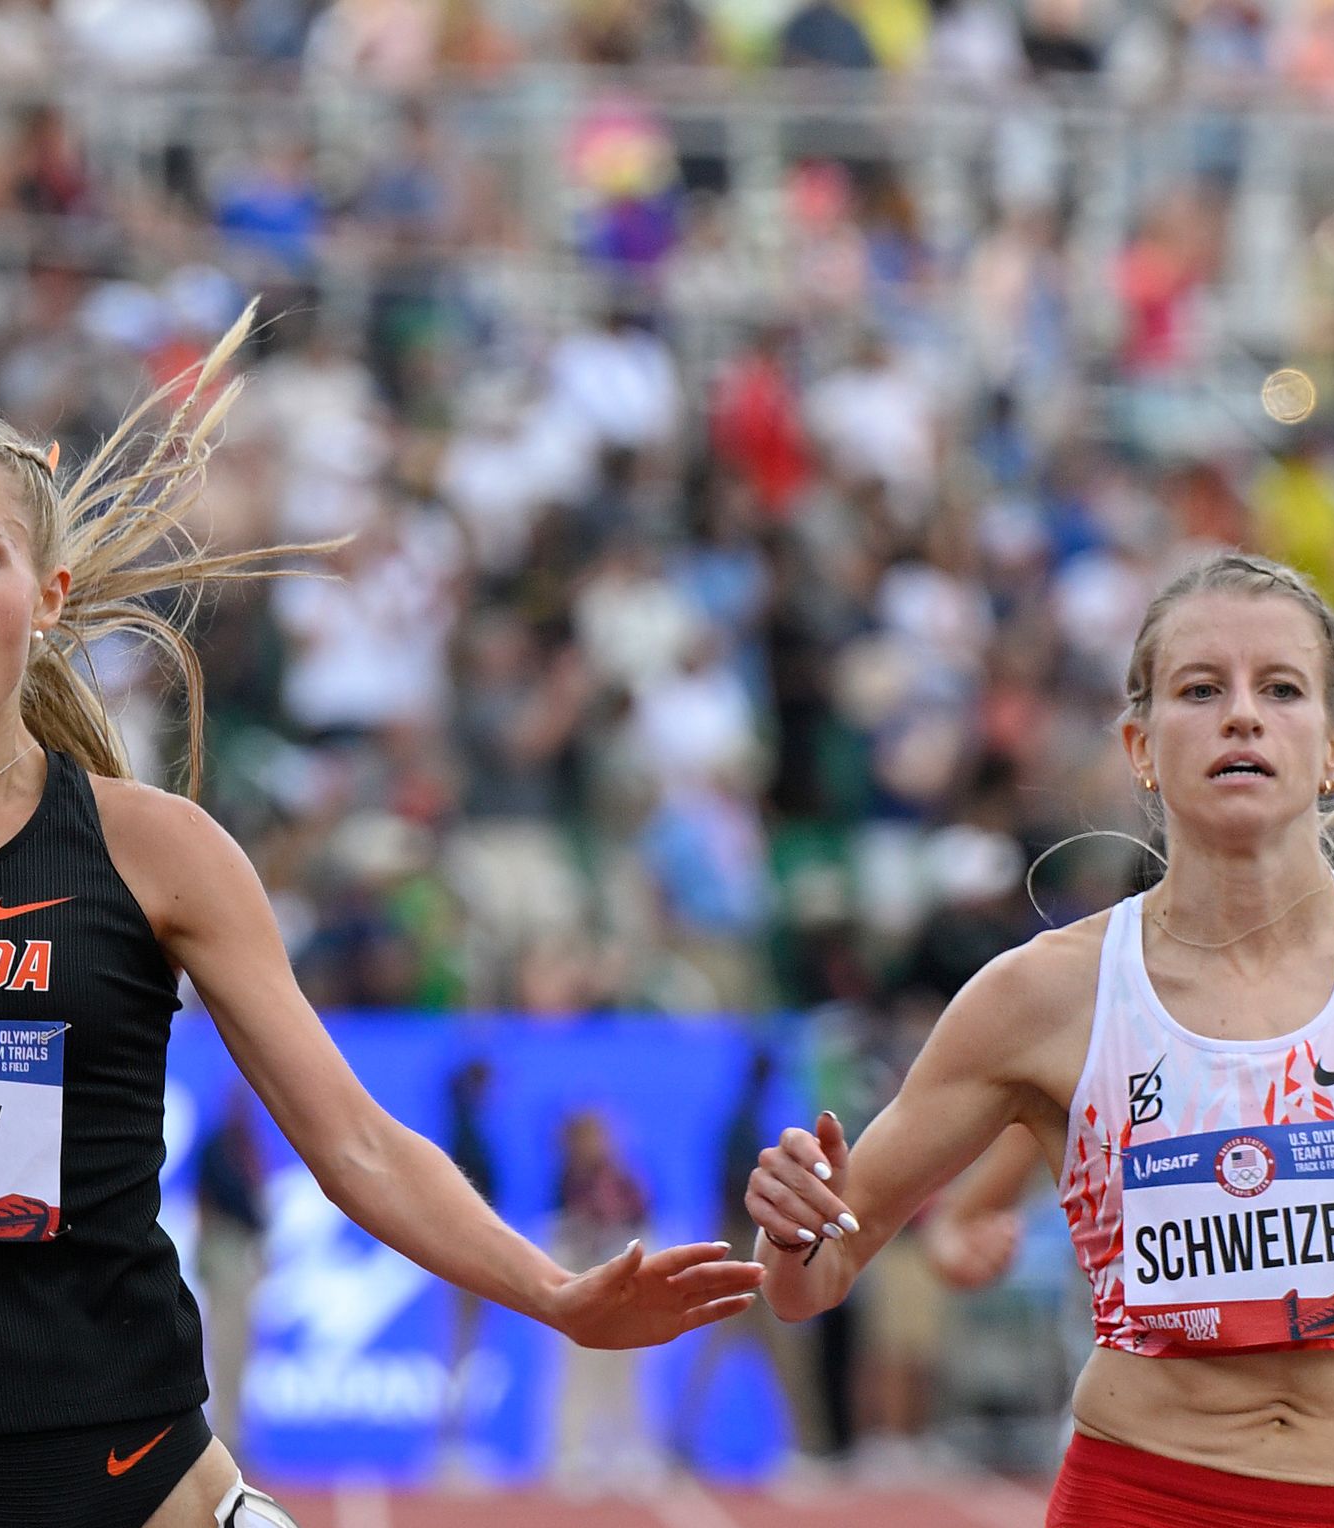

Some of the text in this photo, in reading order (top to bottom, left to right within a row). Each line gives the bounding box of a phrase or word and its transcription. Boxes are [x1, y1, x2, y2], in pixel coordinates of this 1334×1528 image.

[7, 1046, 49, 1061] TRIALS
[8, 1062, 30, 1073] FIELD
[1288, 1132, 1311, 1147] U.S.
[1291, 1146, 1322, 1162] TEAM
[1151, 1152, 1200, 1174] USATF
[1139, 1306, 1221, 1331] TRACKTOWN
[1186, 1323, 1219, 1341] 2024
